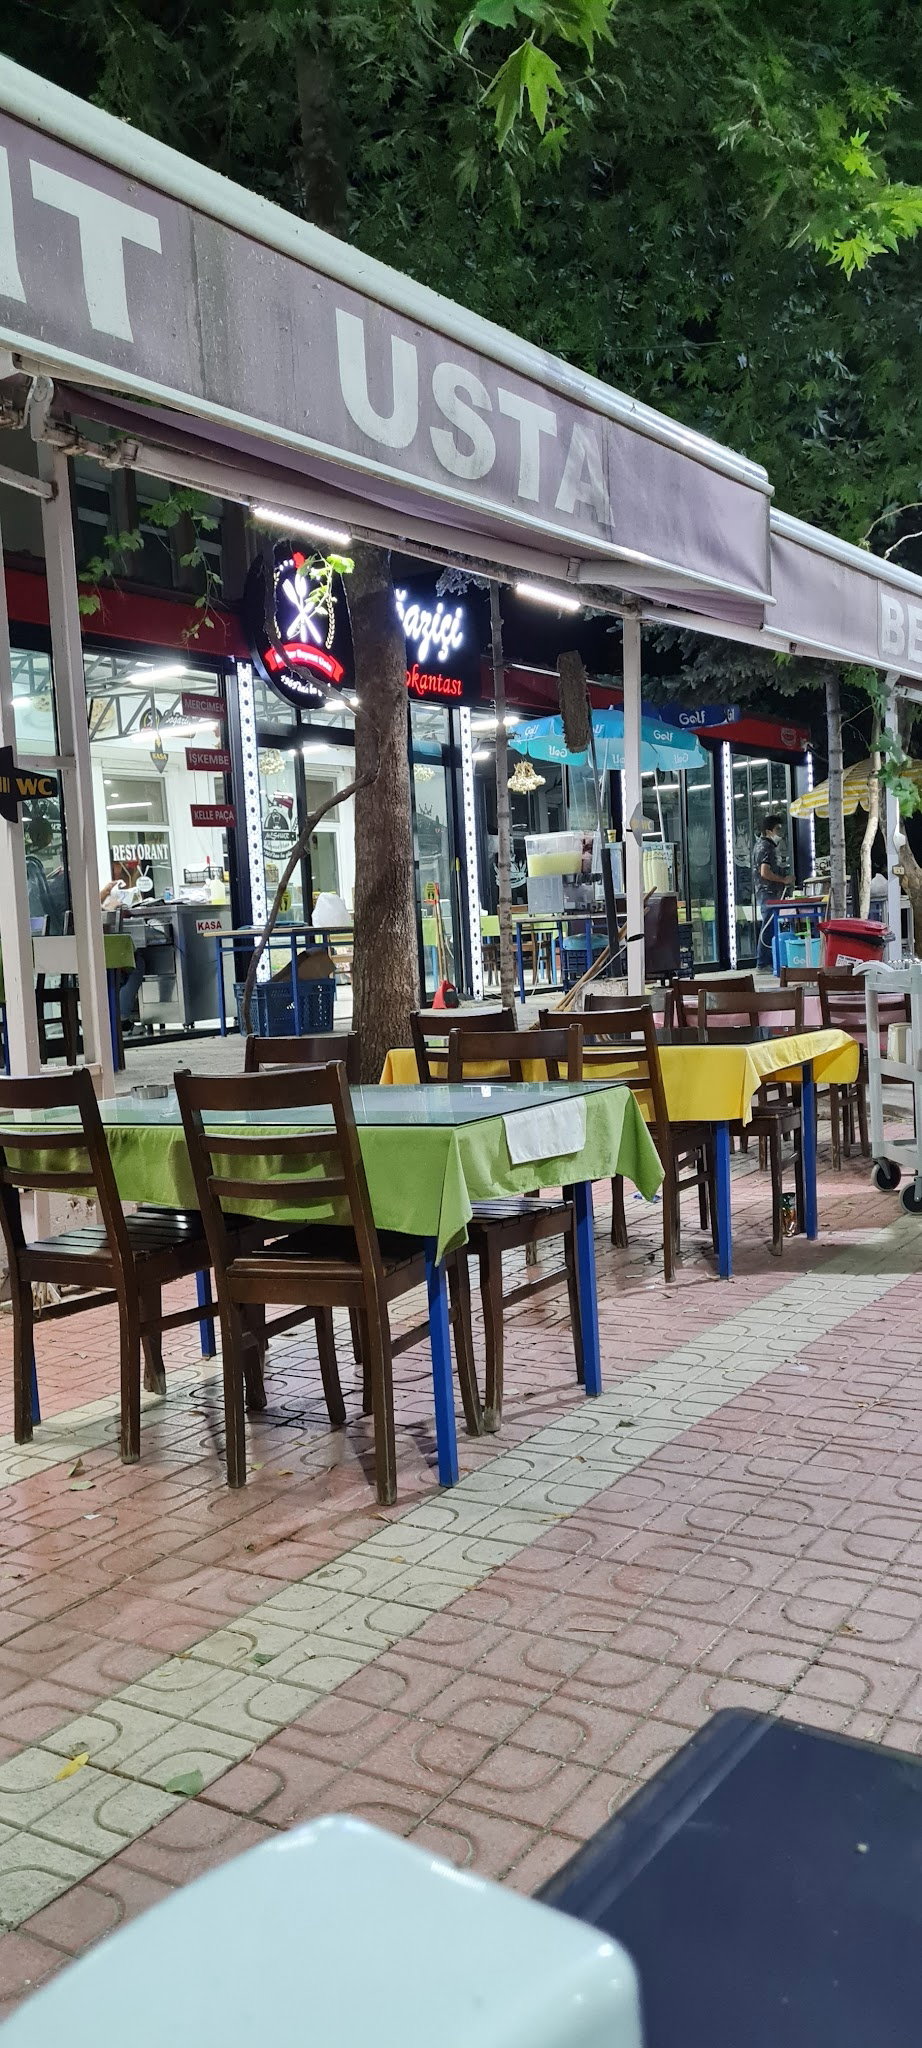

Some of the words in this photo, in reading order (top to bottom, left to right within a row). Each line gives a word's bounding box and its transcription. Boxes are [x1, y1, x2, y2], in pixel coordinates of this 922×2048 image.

[0, 145, 162, 343] T
[336, 307, 615, 517] USTA
[679, 711, 705, 724] Golf
[525, 725, 539, 736] Golf
[653, 730, 673, 742] Golf
[16, 778, 52, 795] WC
[194, 810, 214, 821] KELLE
[215, 811, 235, 823] PAÇA
[112, 843, 168, 861] RESTORANT
[198, 920, 222, 931] KASA
